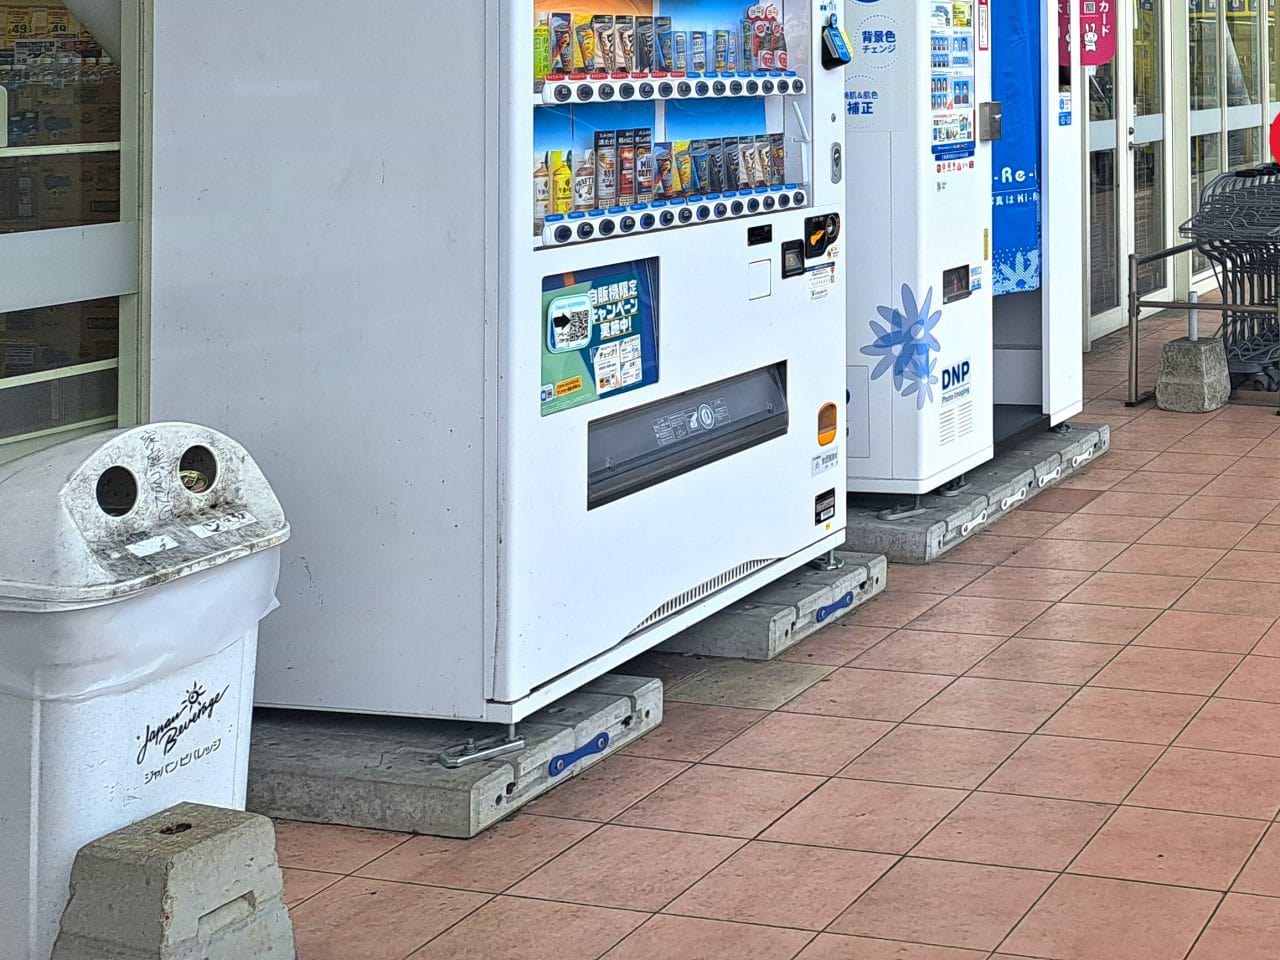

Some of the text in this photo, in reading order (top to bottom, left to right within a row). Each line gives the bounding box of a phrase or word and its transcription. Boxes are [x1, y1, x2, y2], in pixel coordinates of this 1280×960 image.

[862, 30, 896, 44] 背景色
[862, 45, 896, 54] チェンジ
[847, 102, 874, 116] 補正
[588, 279, 637, 305] 自販機限定
[591, 299, 638, 324] キャンペーン
[942, 361, 970, 390] DNP
